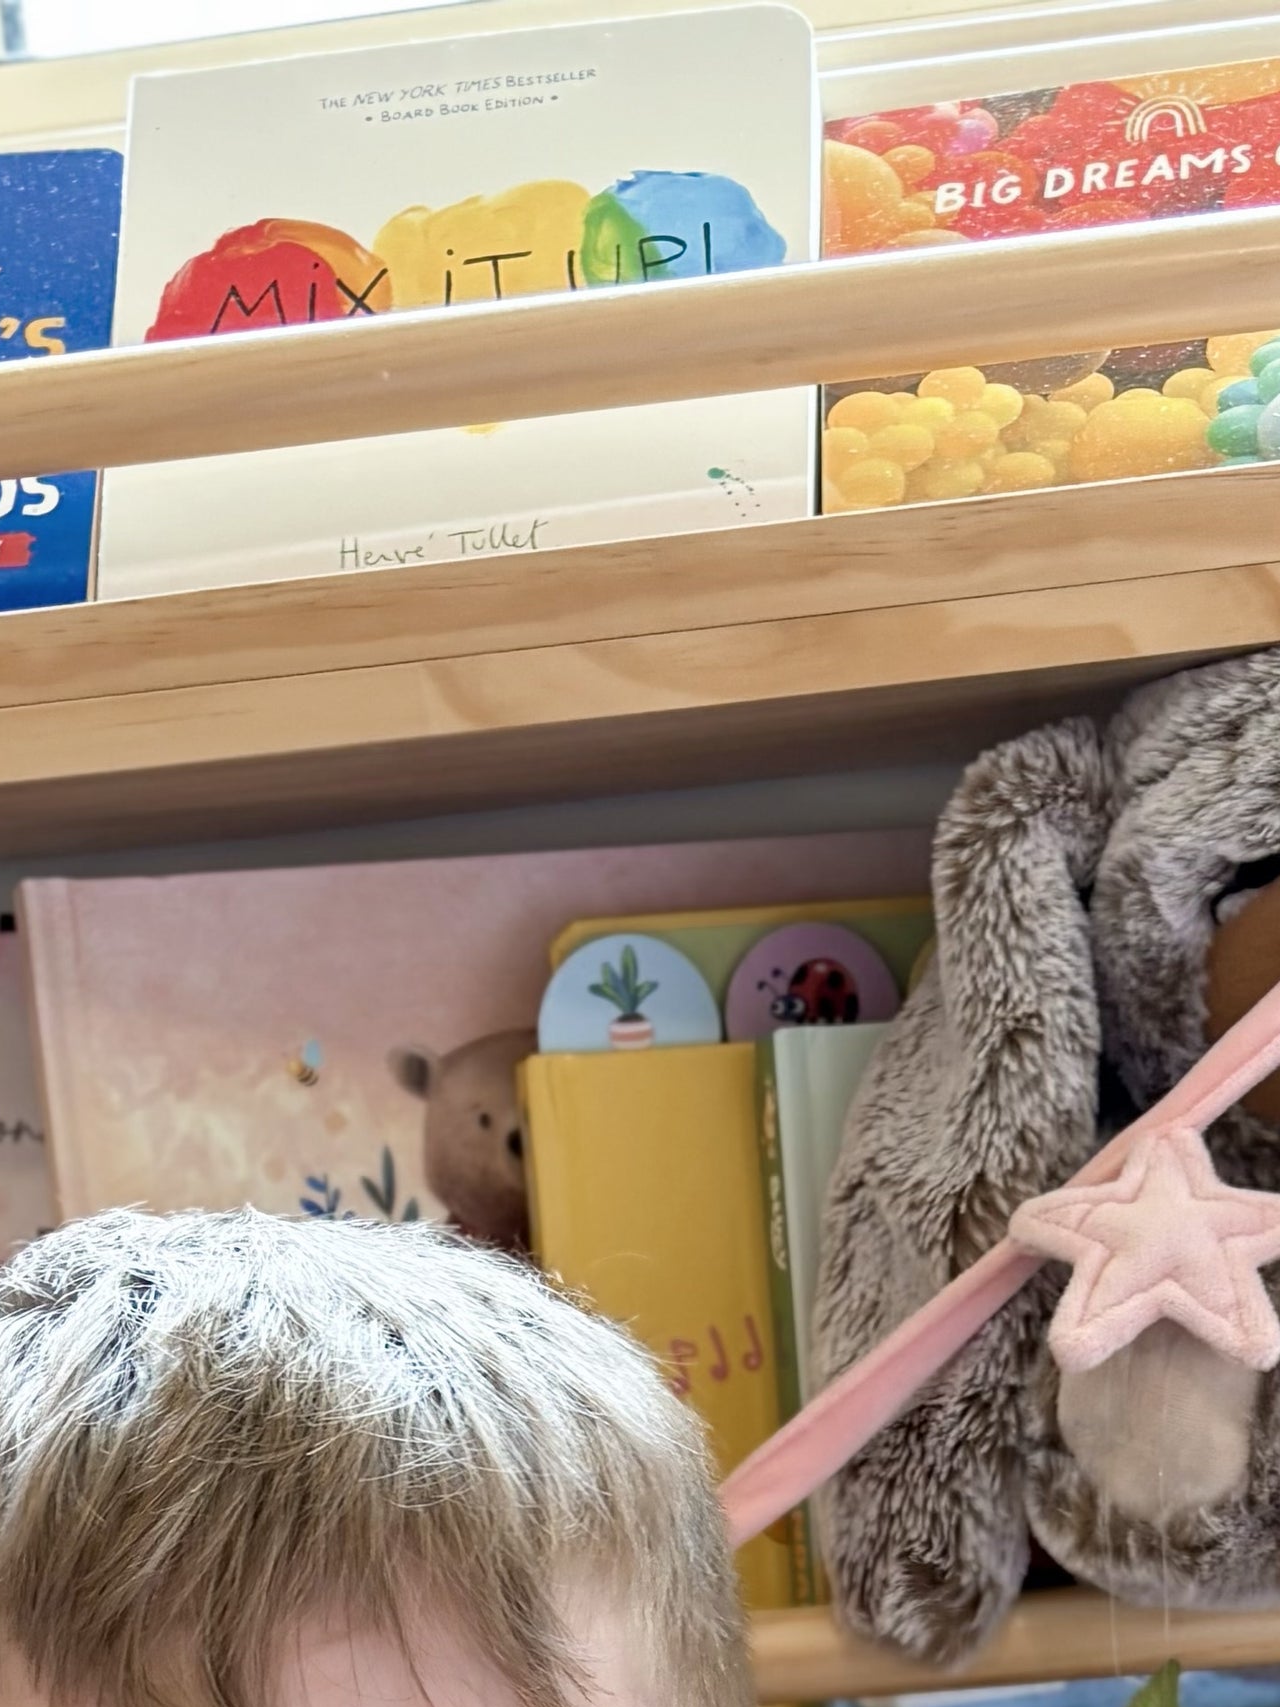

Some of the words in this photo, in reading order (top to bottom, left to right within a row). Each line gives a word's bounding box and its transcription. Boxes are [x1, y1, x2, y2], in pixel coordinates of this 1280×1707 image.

[320, 97, 348, 110] THE
[352, 90, 395, 107] NEW
[399, 83, 447, 101] YORK
[454, 75, 502, 94] TIMES
[505, 68, 597, 88] BESTSELLER
[380, 107, 433, 122] BOARD
[439, 101, 479, 116] BOOK
[934, 174, 1021, 214] BIG
[1043, 143, 1251, 199] DREAMS
